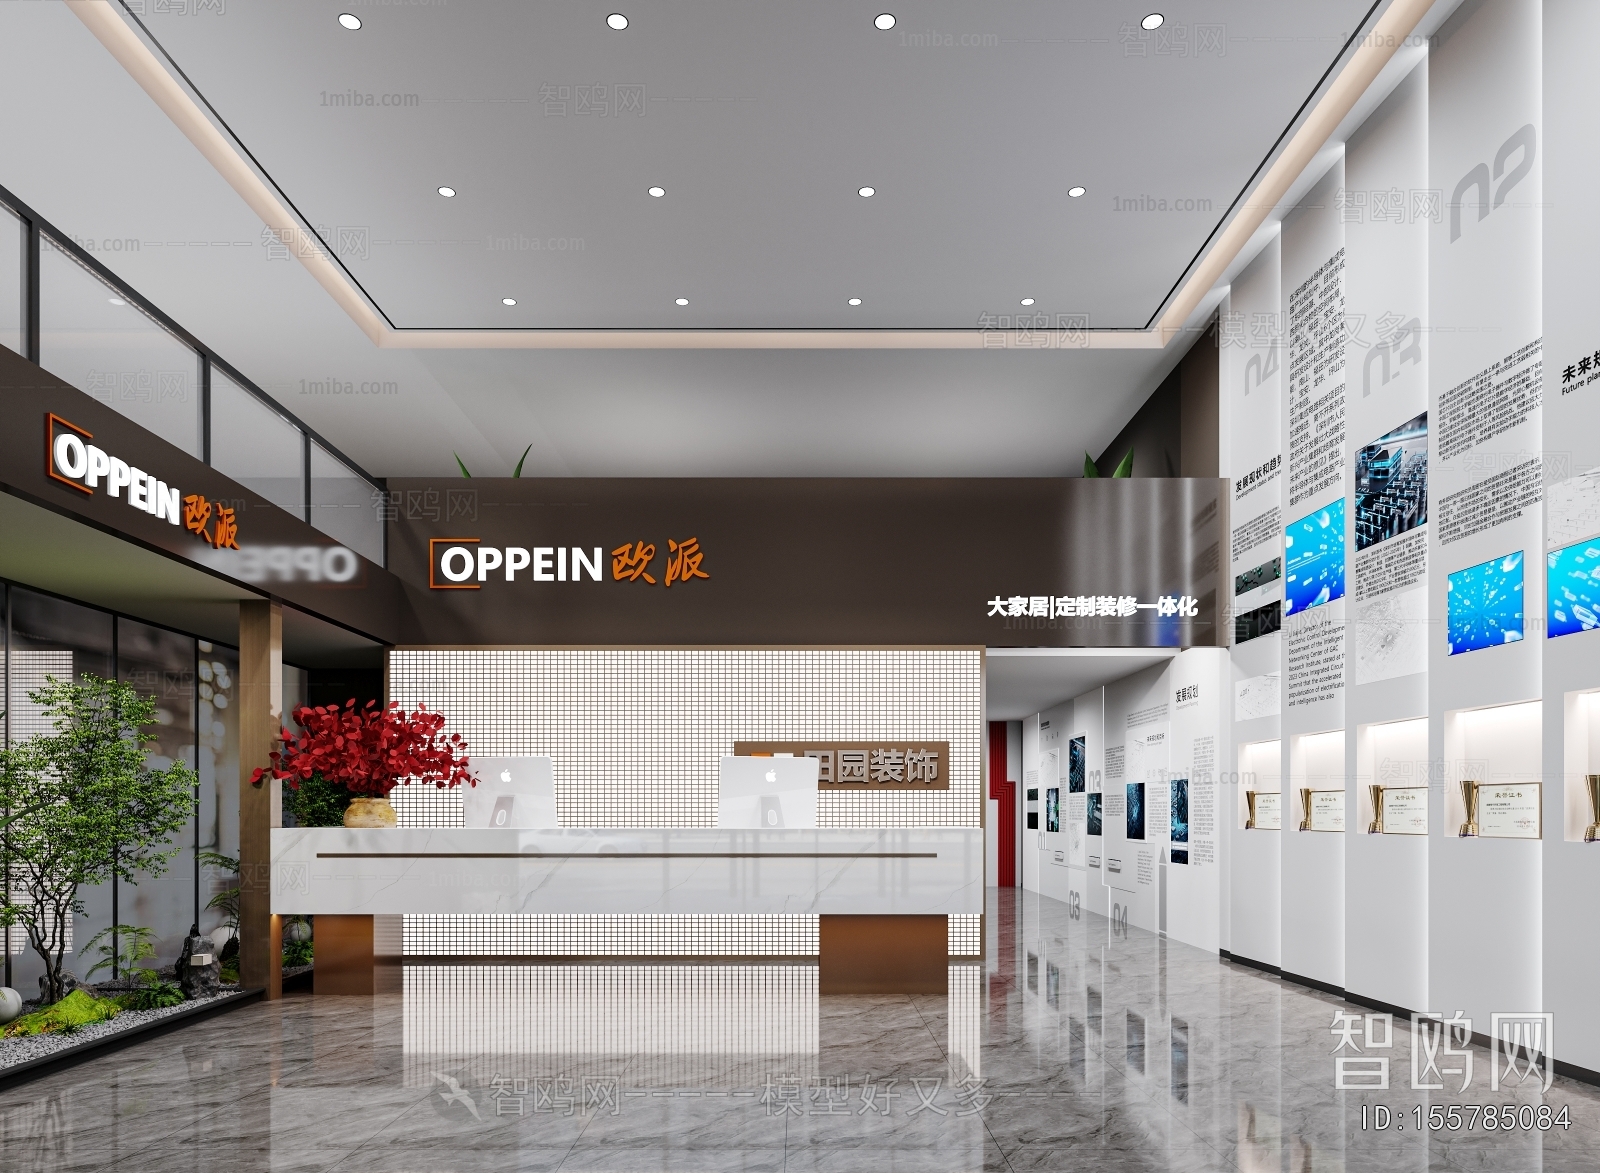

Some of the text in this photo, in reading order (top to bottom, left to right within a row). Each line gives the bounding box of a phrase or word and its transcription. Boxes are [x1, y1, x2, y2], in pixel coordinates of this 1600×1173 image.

[1561, 379, 1585, 396] Future
[54, 433, 241, 551] OPPEIN 欧派
[440, 537, 711, 587] OPPEIN 欧派
[1288, 644, 1309, 656] Department
[1323, 635, 1343, 647] Intelligent
[1288, 652, 1309, 664] Networking
[1310, 649, 1322, 657] Center
[1288, 663, 1304, 671] Research
[1288, 681, 1302, 689] Summit
[1319, 673, 1341, 683] accelerated
[1288, 687, 1314, 699] popularization
[1296, 696, 1317, 706] intelligence
